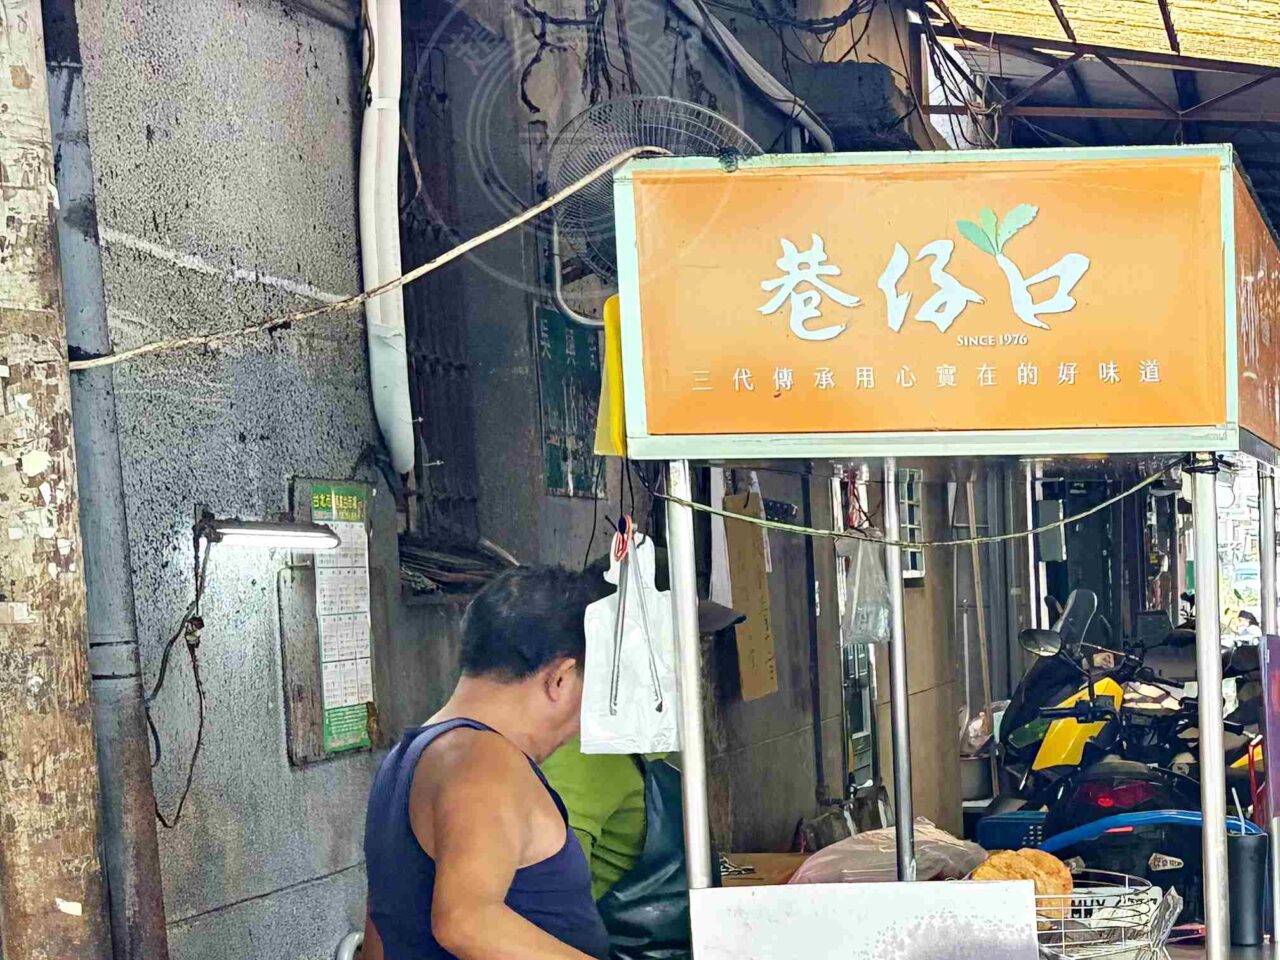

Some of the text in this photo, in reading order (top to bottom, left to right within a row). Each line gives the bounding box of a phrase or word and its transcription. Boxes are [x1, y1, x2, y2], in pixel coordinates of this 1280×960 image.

[758, 232, 1092, 342] 巷仔口
[957, 333, 1029, 347] SINCE 1976
[691, 359, 1162, 391] 三代傳承用心實在的好味道
